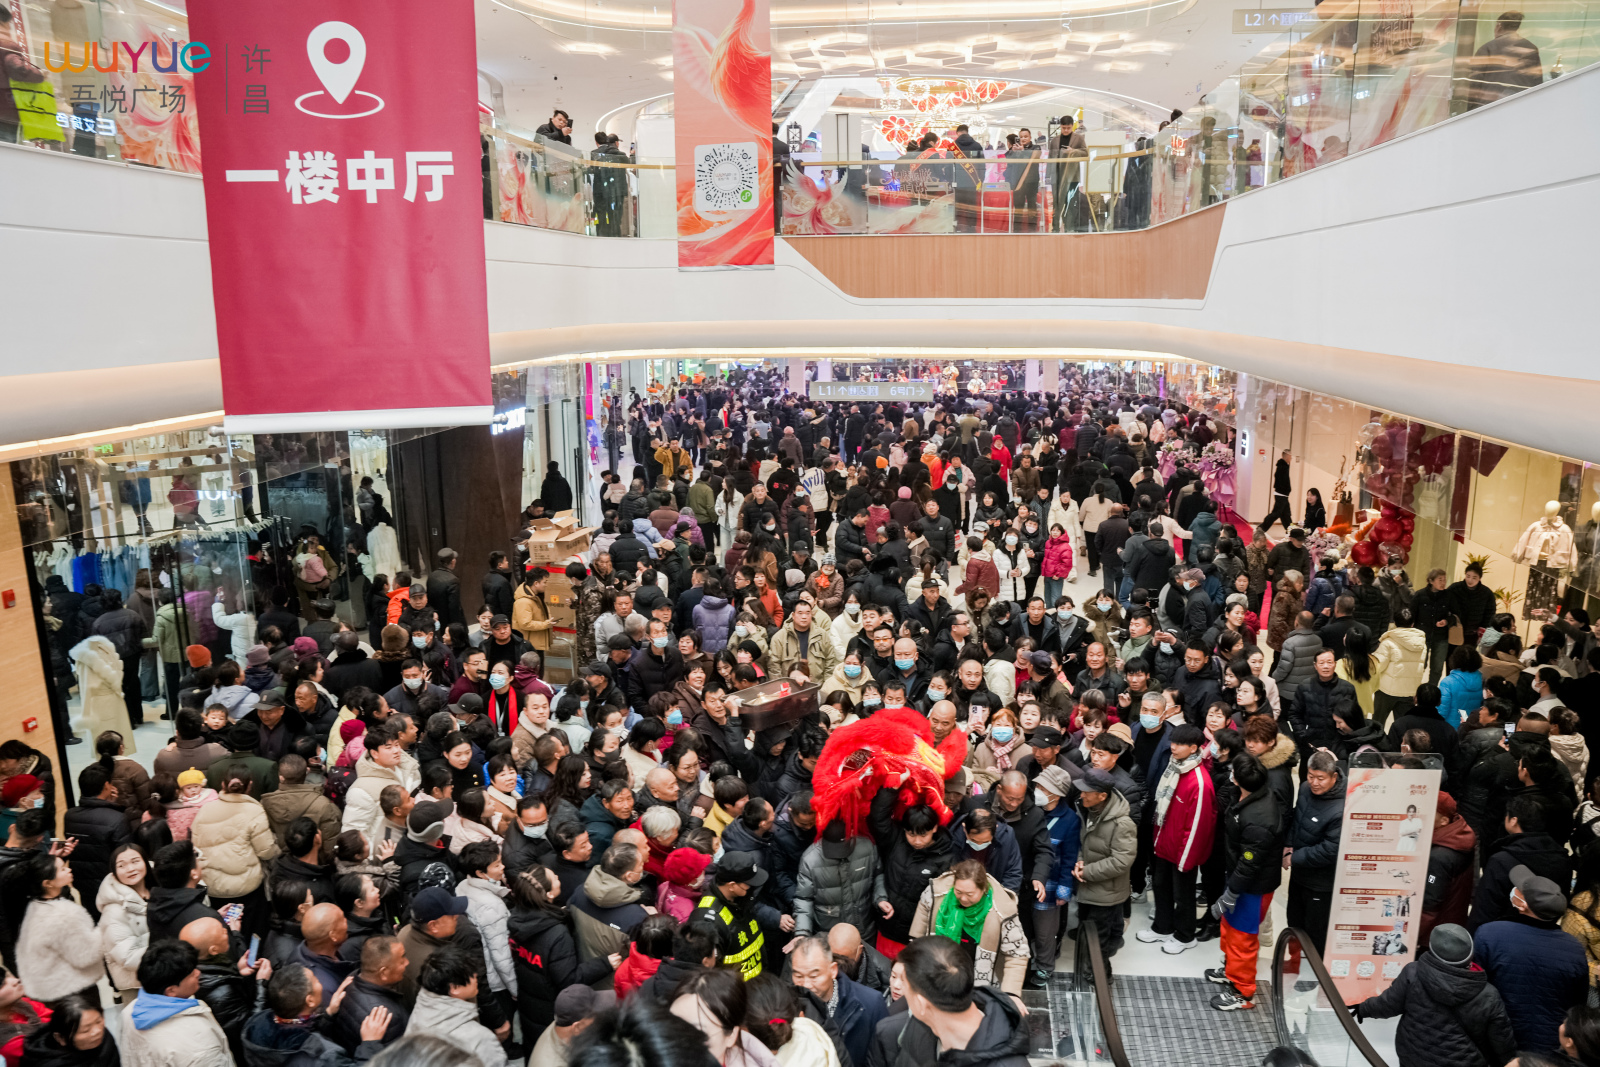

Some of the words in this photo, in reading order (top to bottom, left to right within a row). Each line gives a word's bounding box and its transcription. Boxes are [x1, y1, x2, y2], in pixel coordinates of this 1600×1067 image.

[1244, 13, 1262, 27] L2
[225, 150, 455, 205] 一楼中厅
